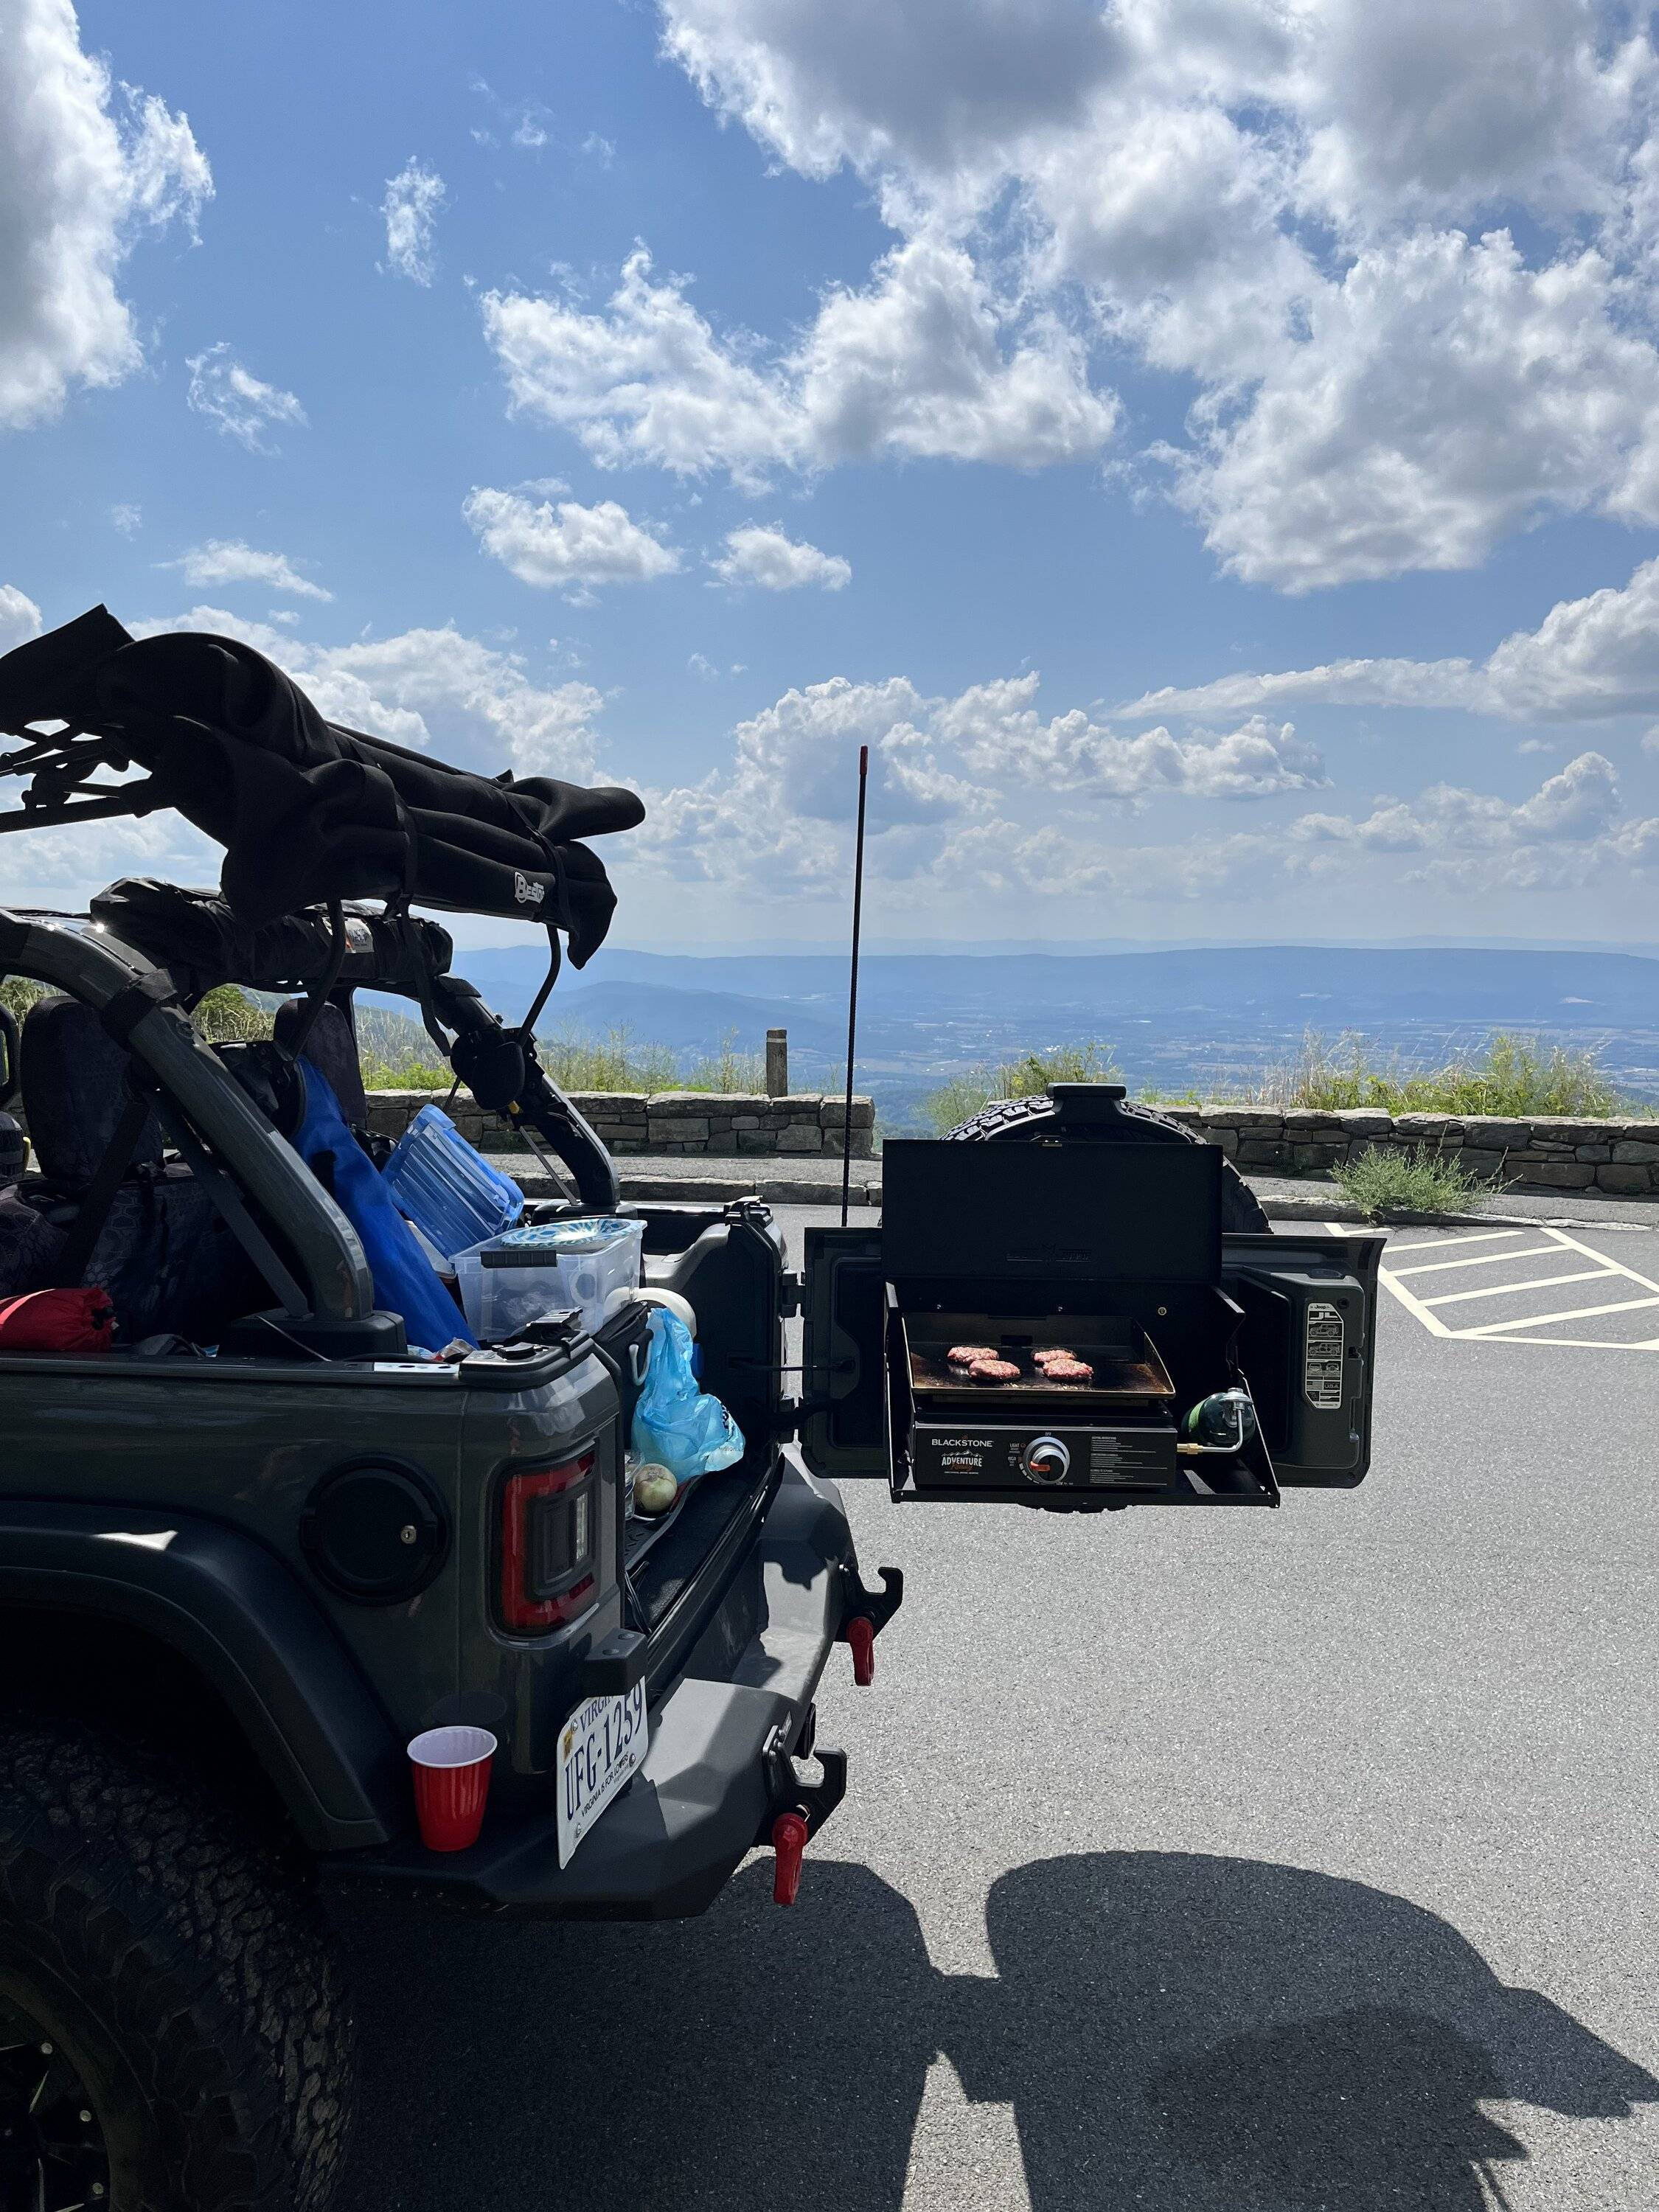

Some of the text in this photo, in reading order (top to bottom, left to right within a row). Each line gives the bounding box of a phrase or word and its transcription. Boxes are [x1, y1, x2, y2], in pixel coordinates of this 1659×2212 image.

[931, 1439, 993, 1447] BLACKSTONE
[941, 1456, 983, 1467] ADVENTURE
[581, 1789, 602, 1818] VIRGINIA
[605, 1771, 614, 1787] FOR
